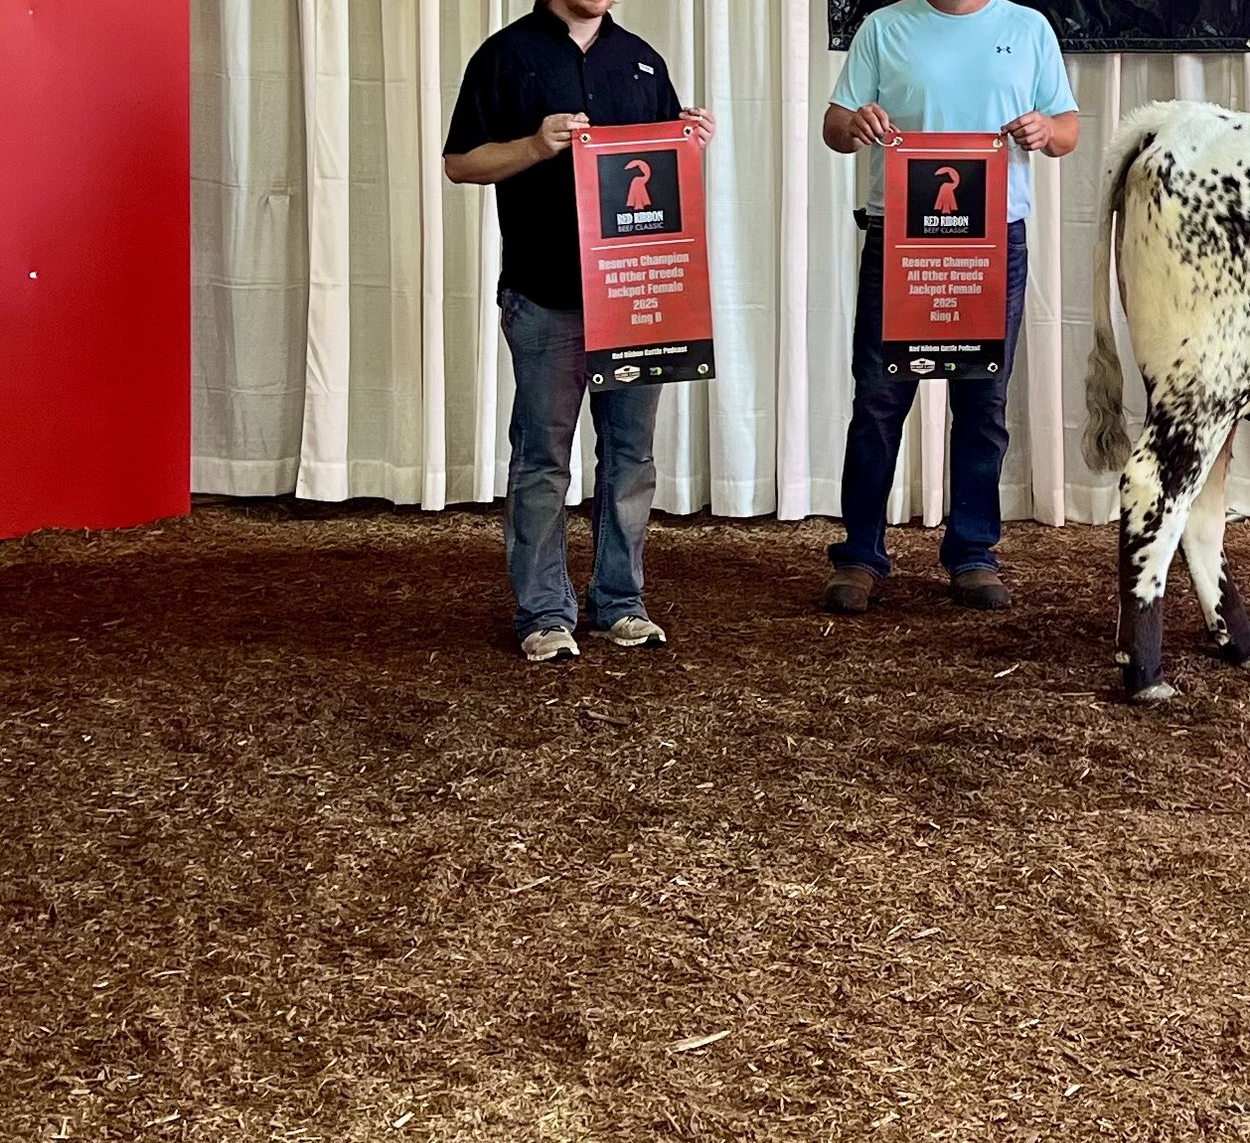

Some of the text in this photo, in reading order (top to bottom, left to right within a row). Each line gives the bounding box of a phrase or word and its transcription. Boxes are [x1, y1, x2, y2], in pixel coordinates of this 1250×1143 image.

[923, 215, 969, 227] RED RIBBON
[598, 252, 690, 271] Reserve Champion
[901, 255, 990, 270] Reserve Champion
[605, 267, 685, 285] All Other Breeds
[907, 269, 984, 282] All Other Breeds
[608, 281, 684, 298] Jackpot Female
[909, 283, 982, 297] Jackpot Female
[632, 298, 659, 311] 2025
[933, 297, 958, 308] 2025
[631, 313, 654, 325] Ring
[930, 310, 960, 323] Ring A
